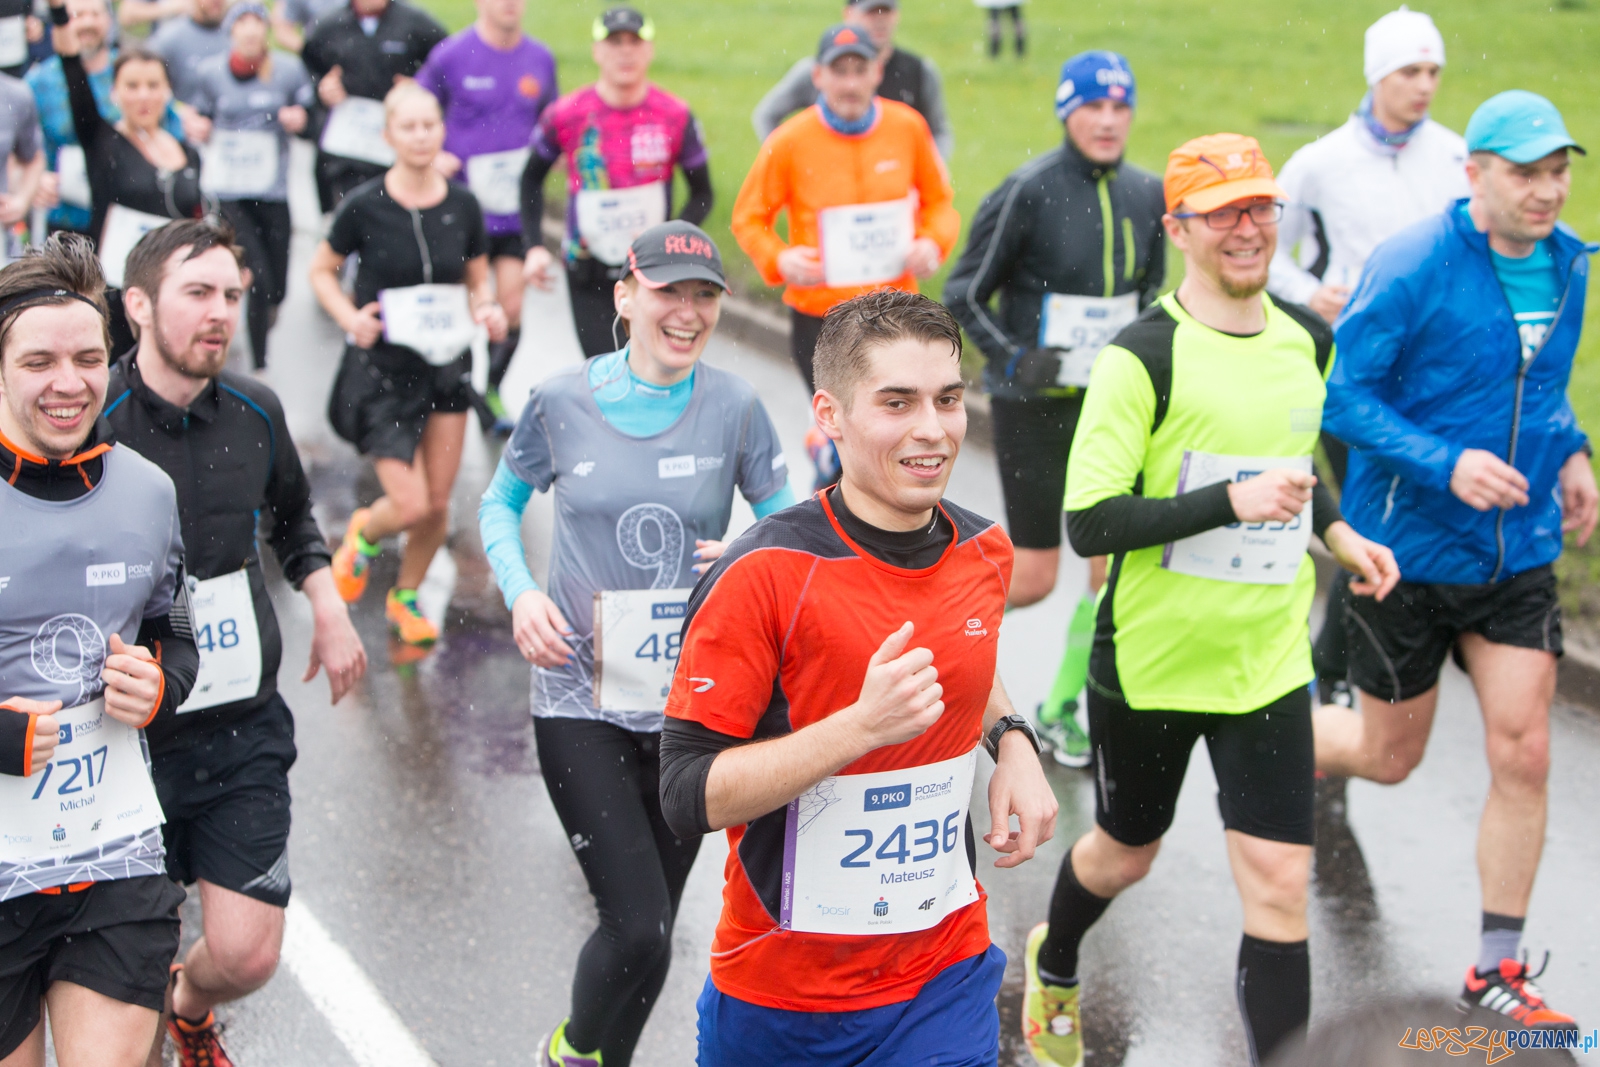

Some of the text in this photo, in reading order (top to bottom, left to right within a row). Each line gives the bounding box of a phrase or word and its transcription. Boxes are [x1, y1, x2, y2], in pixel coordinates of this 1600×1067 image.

[665, 233, 712, 260] RUN
[616, 503, 685, 589] 9
[101, 569, 120, 579] PKO
[664, 605, 684, 616] PKO
[31, 613, 106, 706] 9
[32, 745, 108, 800] 7217
[882, 791, 905, 804] PKO
[91, 819, 102, 832] 4F
[840, 809, 960, 868] 2436
[880, 868, 935, 885] Mateusz
[821, 904, 851, 916] posir
[918, 897, 936, 911] 4F
